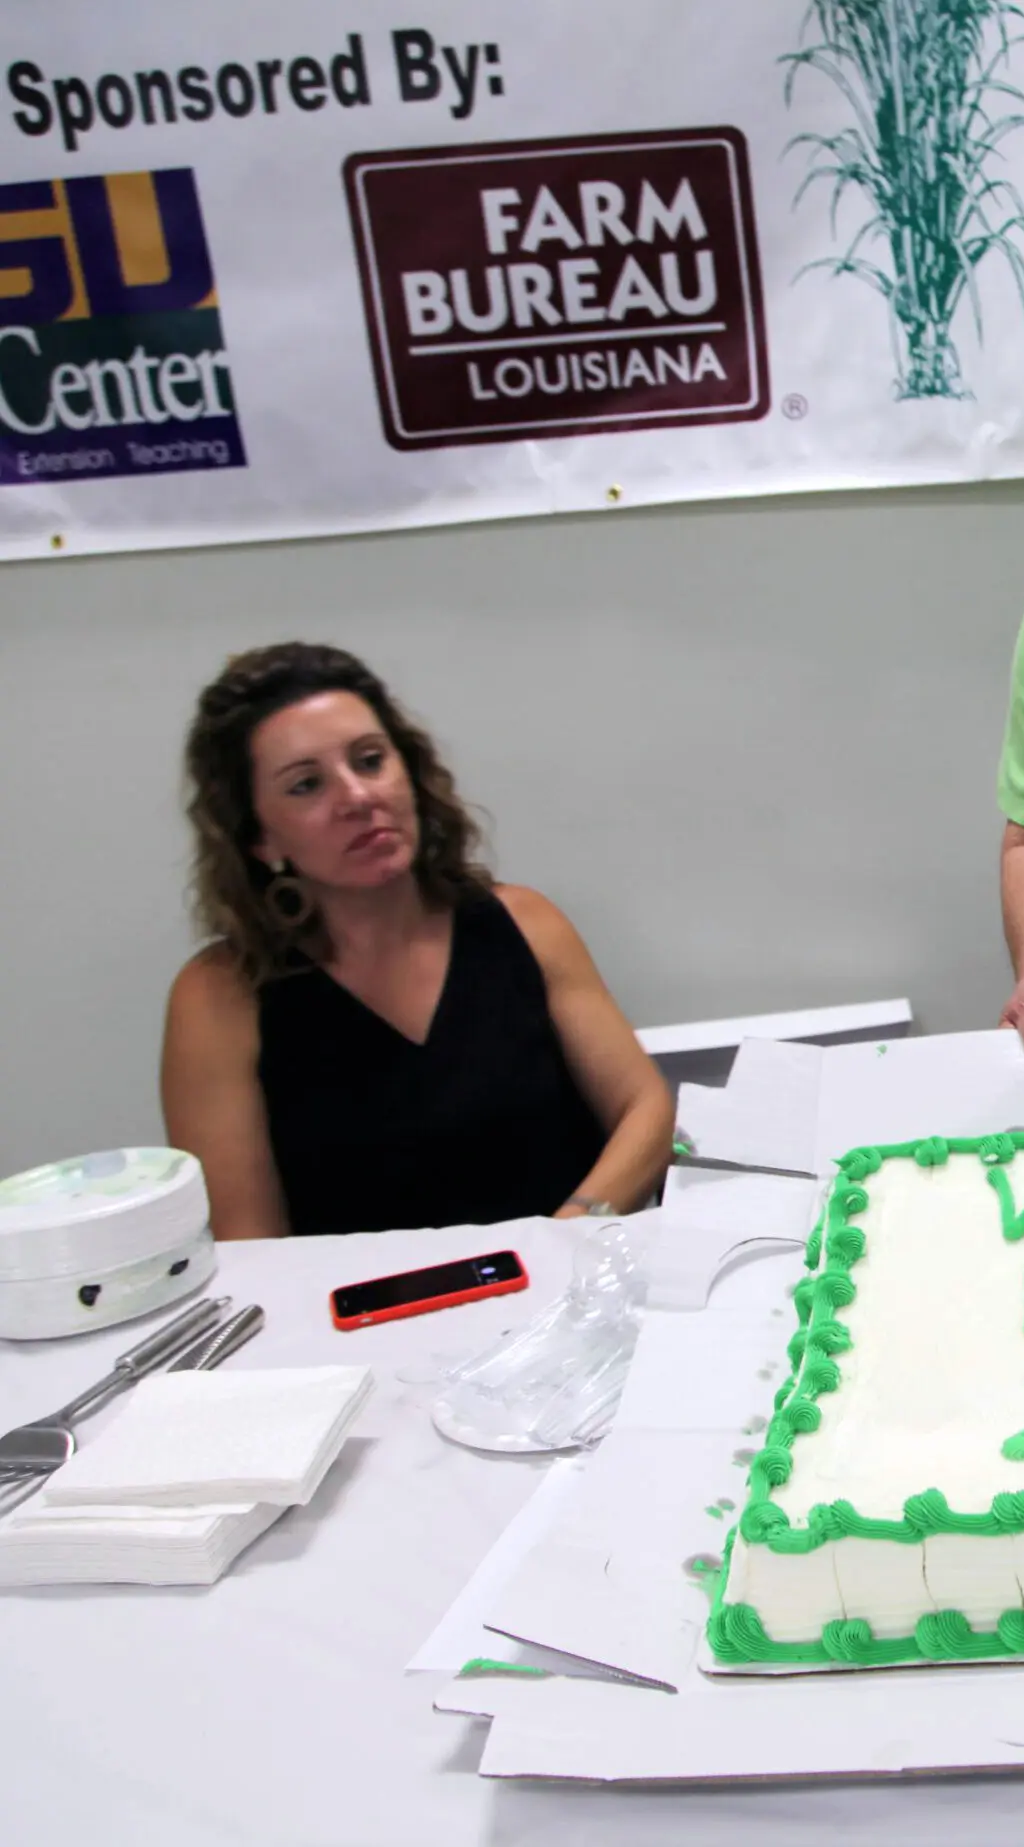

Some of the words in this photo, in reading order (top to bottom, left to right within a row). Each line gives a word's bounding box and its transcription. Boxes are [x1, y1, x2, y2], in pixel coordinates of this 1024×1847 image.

[7, 33, 371, 152] Sponsored
[392, 28, 504, 119] By:
[480, 177, 707, 254] FARM
[401, 249, 718, 336] BUREAU
[468, 343, 728, 400] LOUISIANA
[127, 439, 229, 466] Teaching
